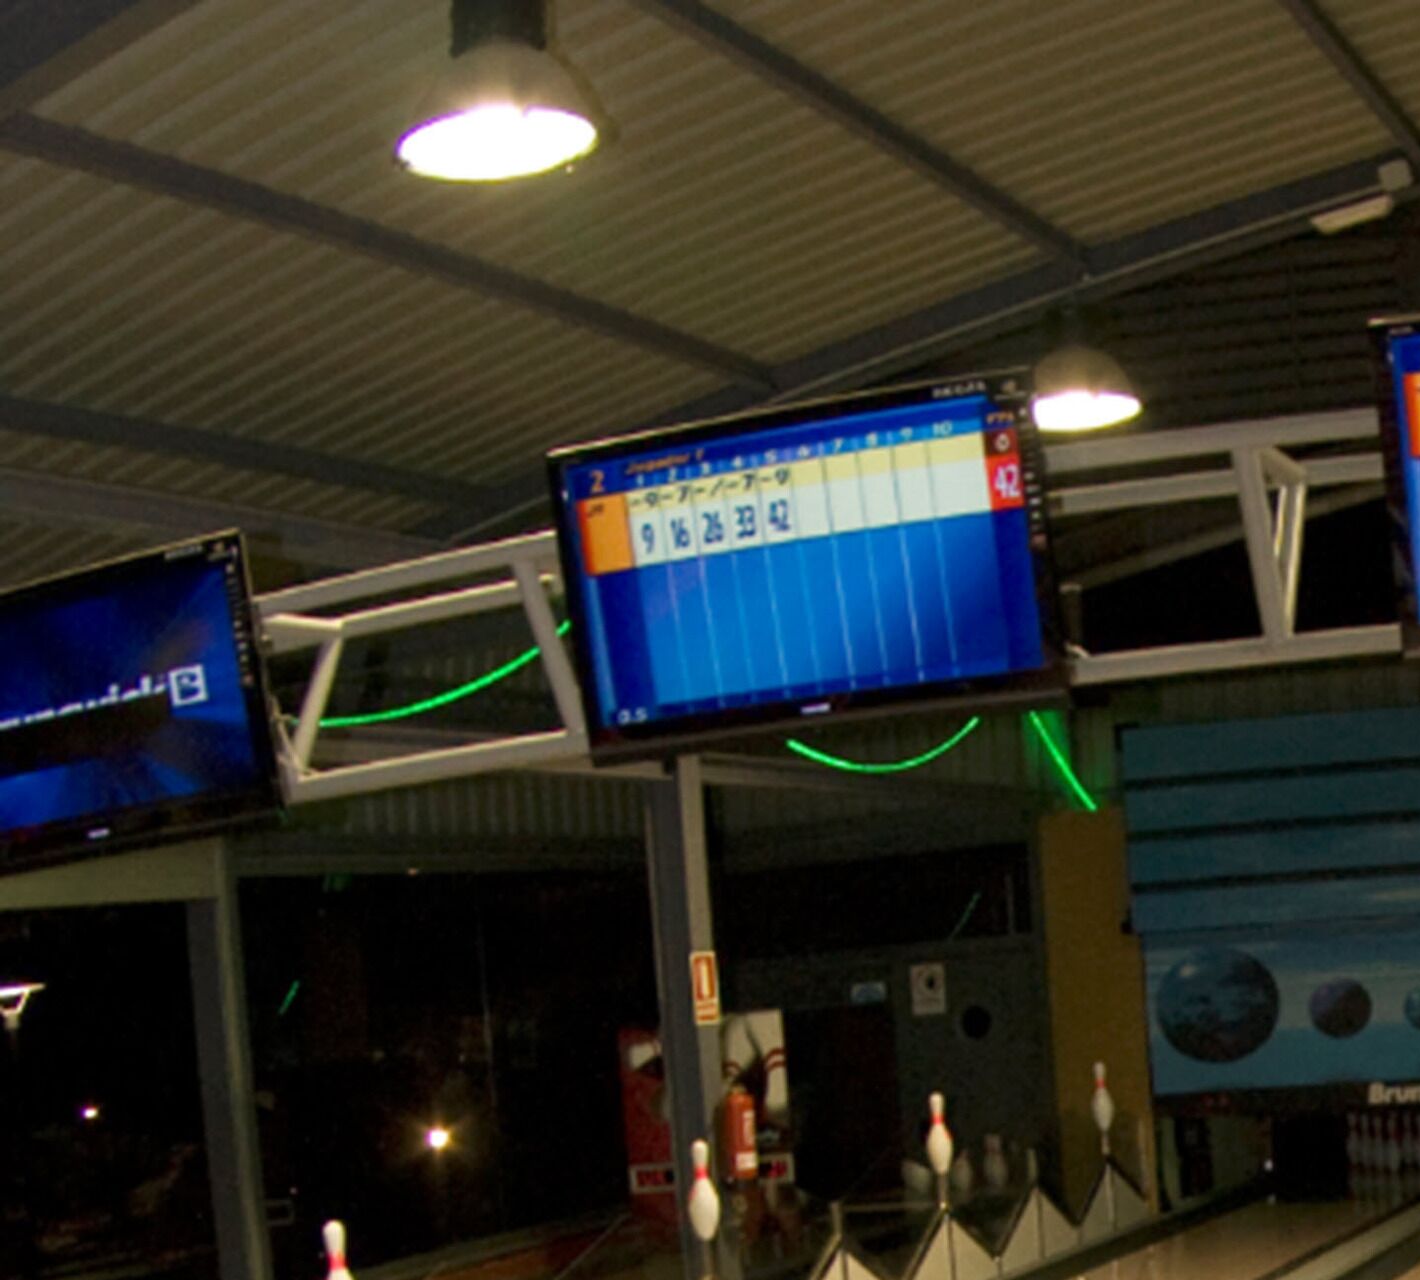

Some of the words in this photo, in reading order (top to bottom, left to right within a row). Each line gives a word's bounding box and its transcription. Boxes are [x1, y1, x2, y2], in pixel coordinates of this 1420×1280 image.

[590, 469, 605, 493] 2
[641, 522, 655, 553] 9
[670, 517, 691, 549] 16
[702, 511, 725, 544] 26
[734, 505, 757, 539] 33
[768, 499, 792, 532] 42
[994, 464, 1022, 499] 42
